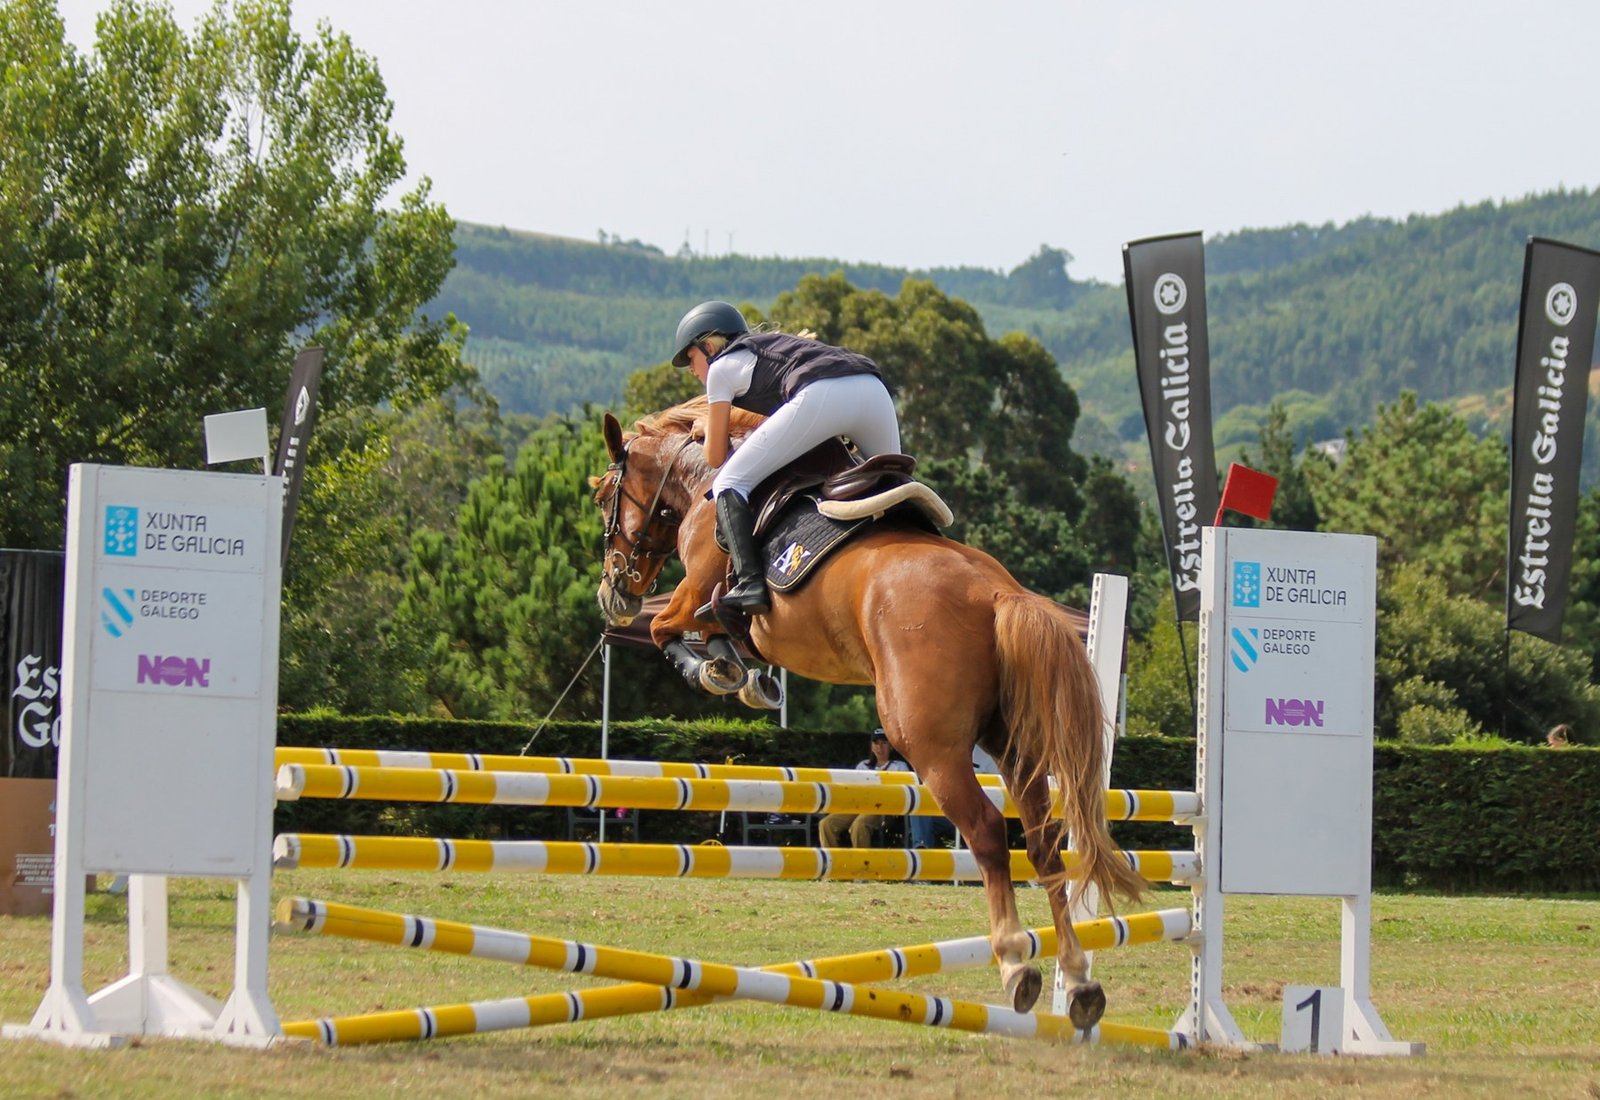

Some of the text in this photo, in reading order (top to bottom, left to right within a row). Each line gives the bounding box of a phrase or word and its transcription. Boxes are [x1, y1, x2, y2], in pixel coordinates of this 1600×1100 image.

[1160, 321, 1202, 592] Estrella Galicia
[1513, 336, 1570, 610] Estrella Galicia
[146, 511, 207, 532] XUNTA
[144, 533, 244, 556] DE GALICIA
[1266, 567, 1316, 585] XUNTA
[140, 589, 207, 606] DEPORTE
[1266, 586, 1347, 606] DE GALICIA
[140, 605, 199, 620] GALEGO
[1263, 629, 1316, 642] DEPORTE
[1263, 643, 1310, 655] GALEGO
[12, 654, 62, 699] Es
[1296, 989, 1321, 1053] 1
